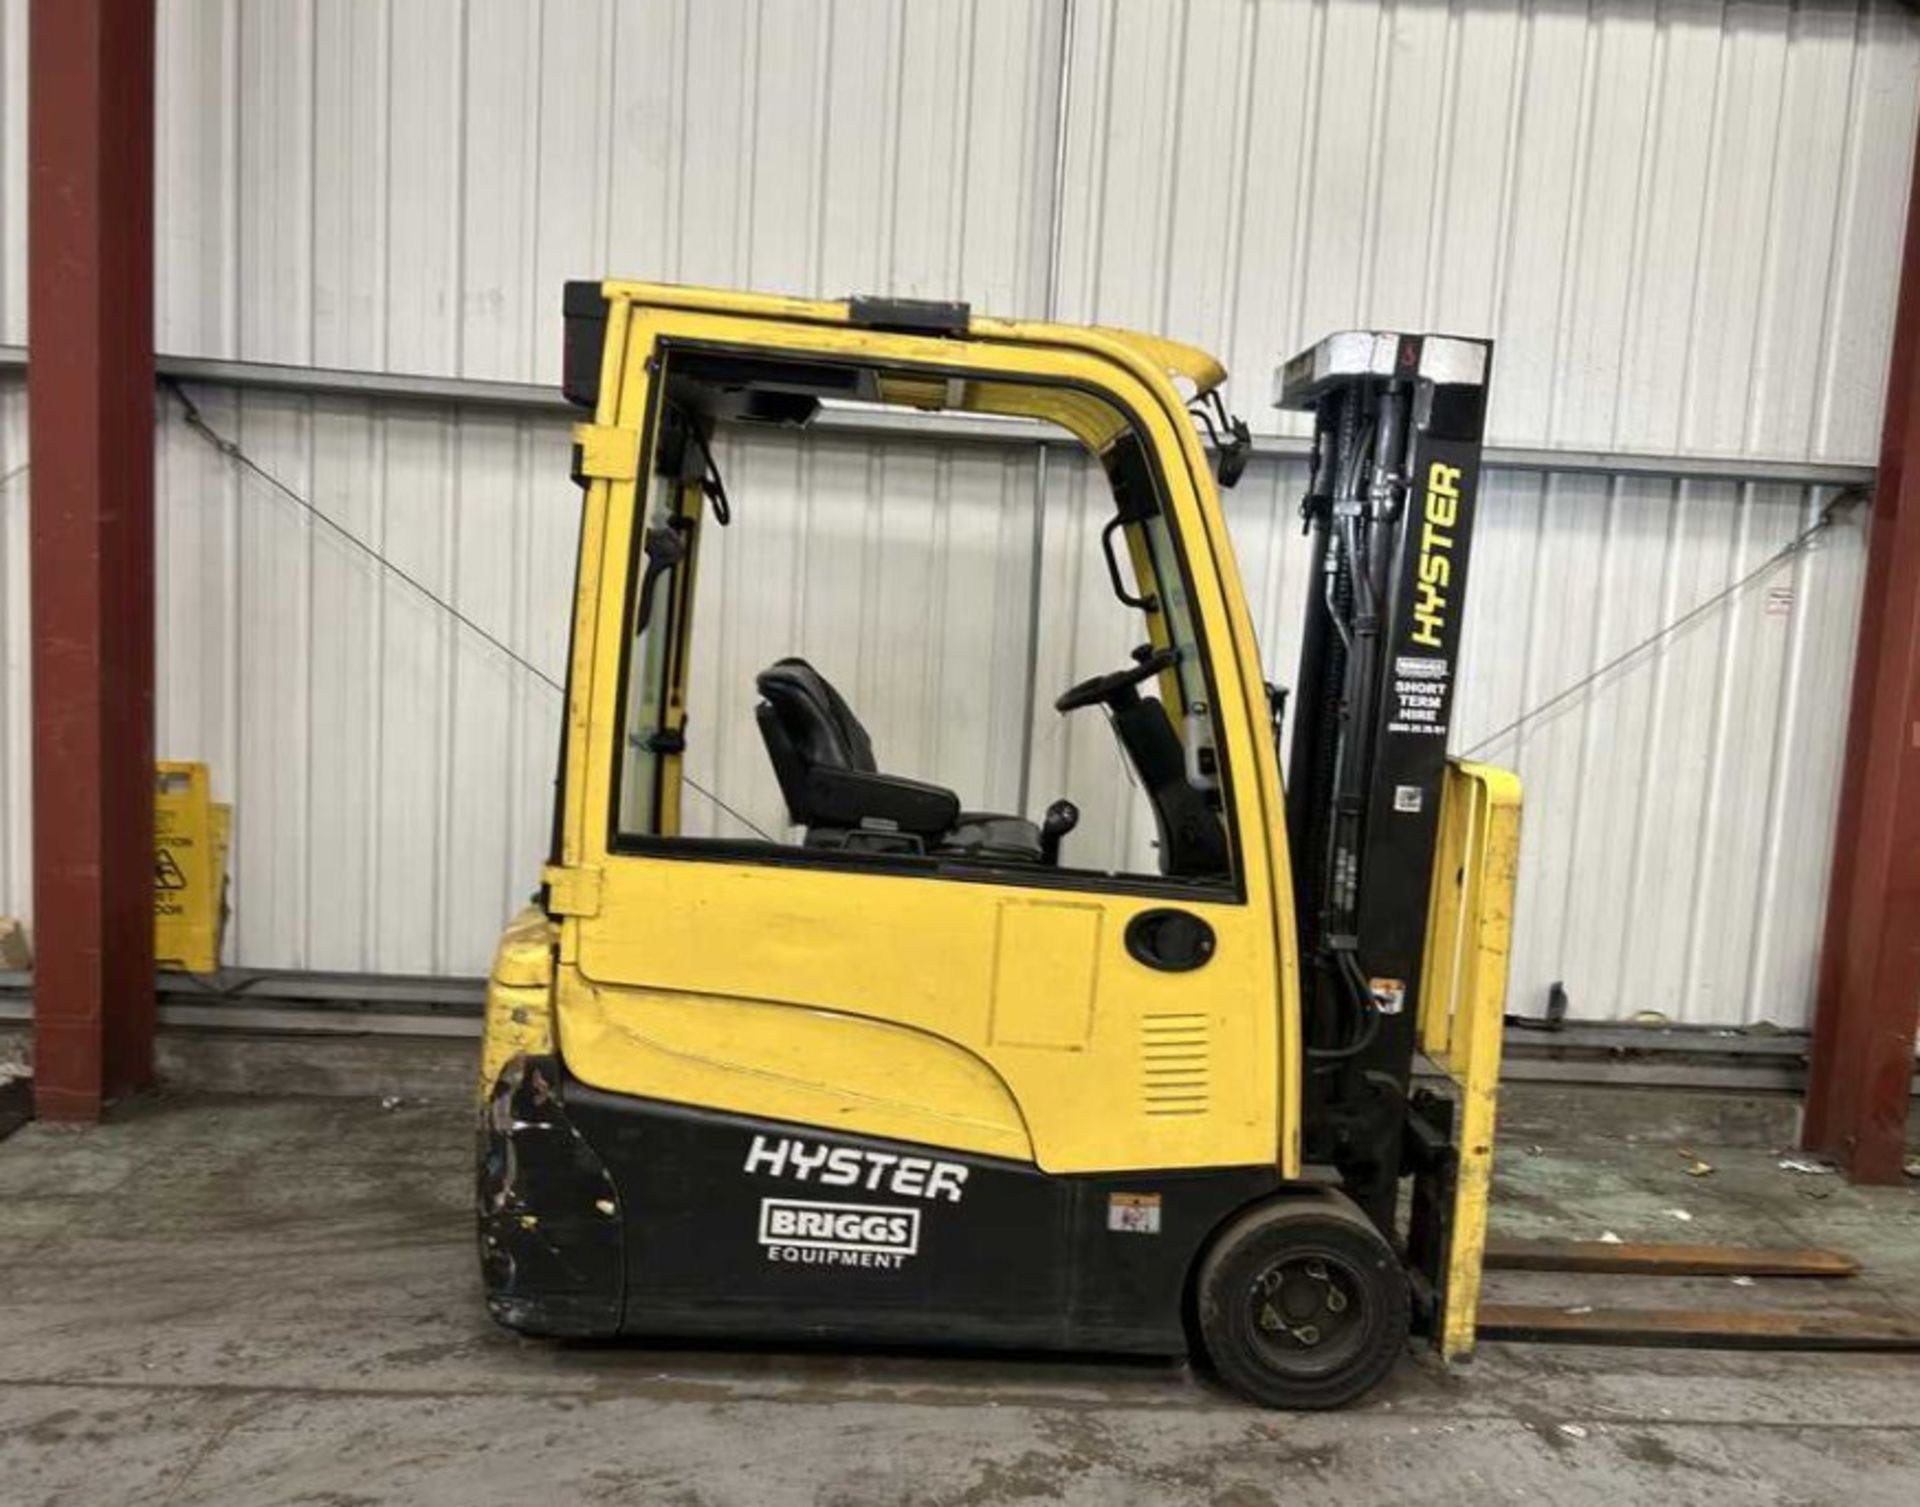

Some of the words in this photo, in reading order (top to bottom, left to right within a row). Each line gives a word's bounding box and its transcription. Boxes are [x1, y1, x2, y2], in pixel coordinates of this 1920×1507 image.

[1411, 461, 1461, 648] HYSTER
[1395, 681, 1447, 695] SHORT
[1398, 694, 1442, 709] TERM
[1399, 708, 1437, 721] HIRE
[744, 1135, 969, 1202] HYSTER
[769, 1208, 908, 1244] BRIGGS
[767, 1245, 905, 1269] EQUIPMENT
